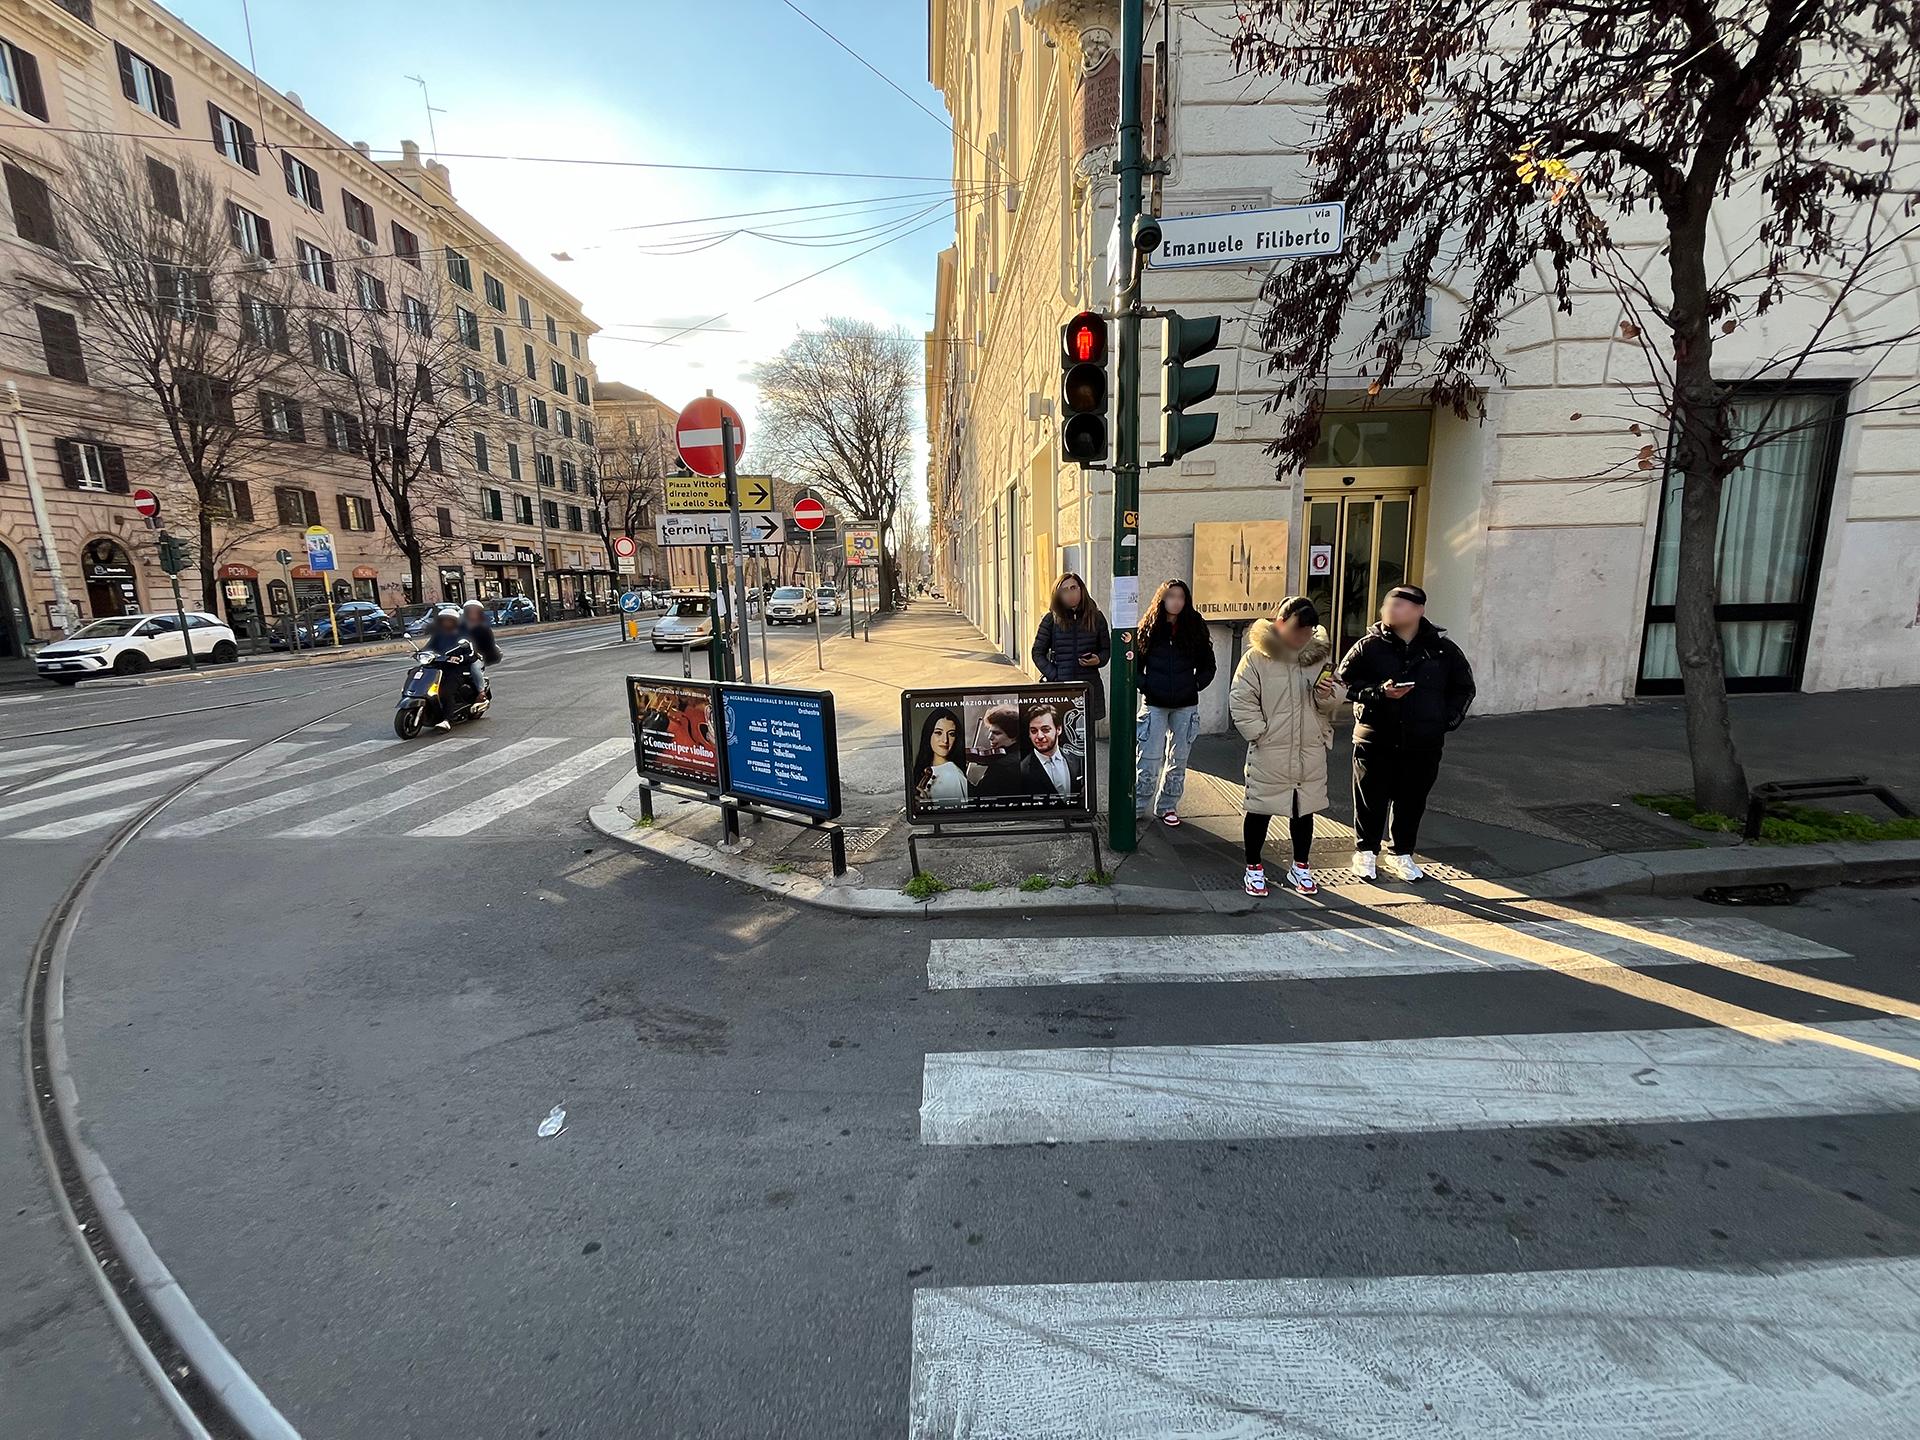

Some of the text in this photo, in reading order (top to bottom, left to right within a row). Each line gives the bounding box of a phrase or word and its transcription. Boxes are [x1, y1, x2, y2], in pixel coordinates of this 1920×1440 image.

[1163, 228, 1330, 257] Emanuele Filiberto
[669, 490, 708, 498] direzione
[661, 523, 711, 536] termini
[1196, 603, 1222, 613] HOTEL
[1223, 602, 1255, 612] MILTON
[960, 699, 1000, 707] NAZIONALE
[1039, 696, 1069, 704] CECILIA
[797, 708, 820, 716] Orchestra
[648, 736, 677, 751] Concerti
[677, 744, 689, 755] per
[690, 744, 714, 759] violino
[773, 747, 796, 759] Sibelius
[774, 761, 790, 770] Andrea
